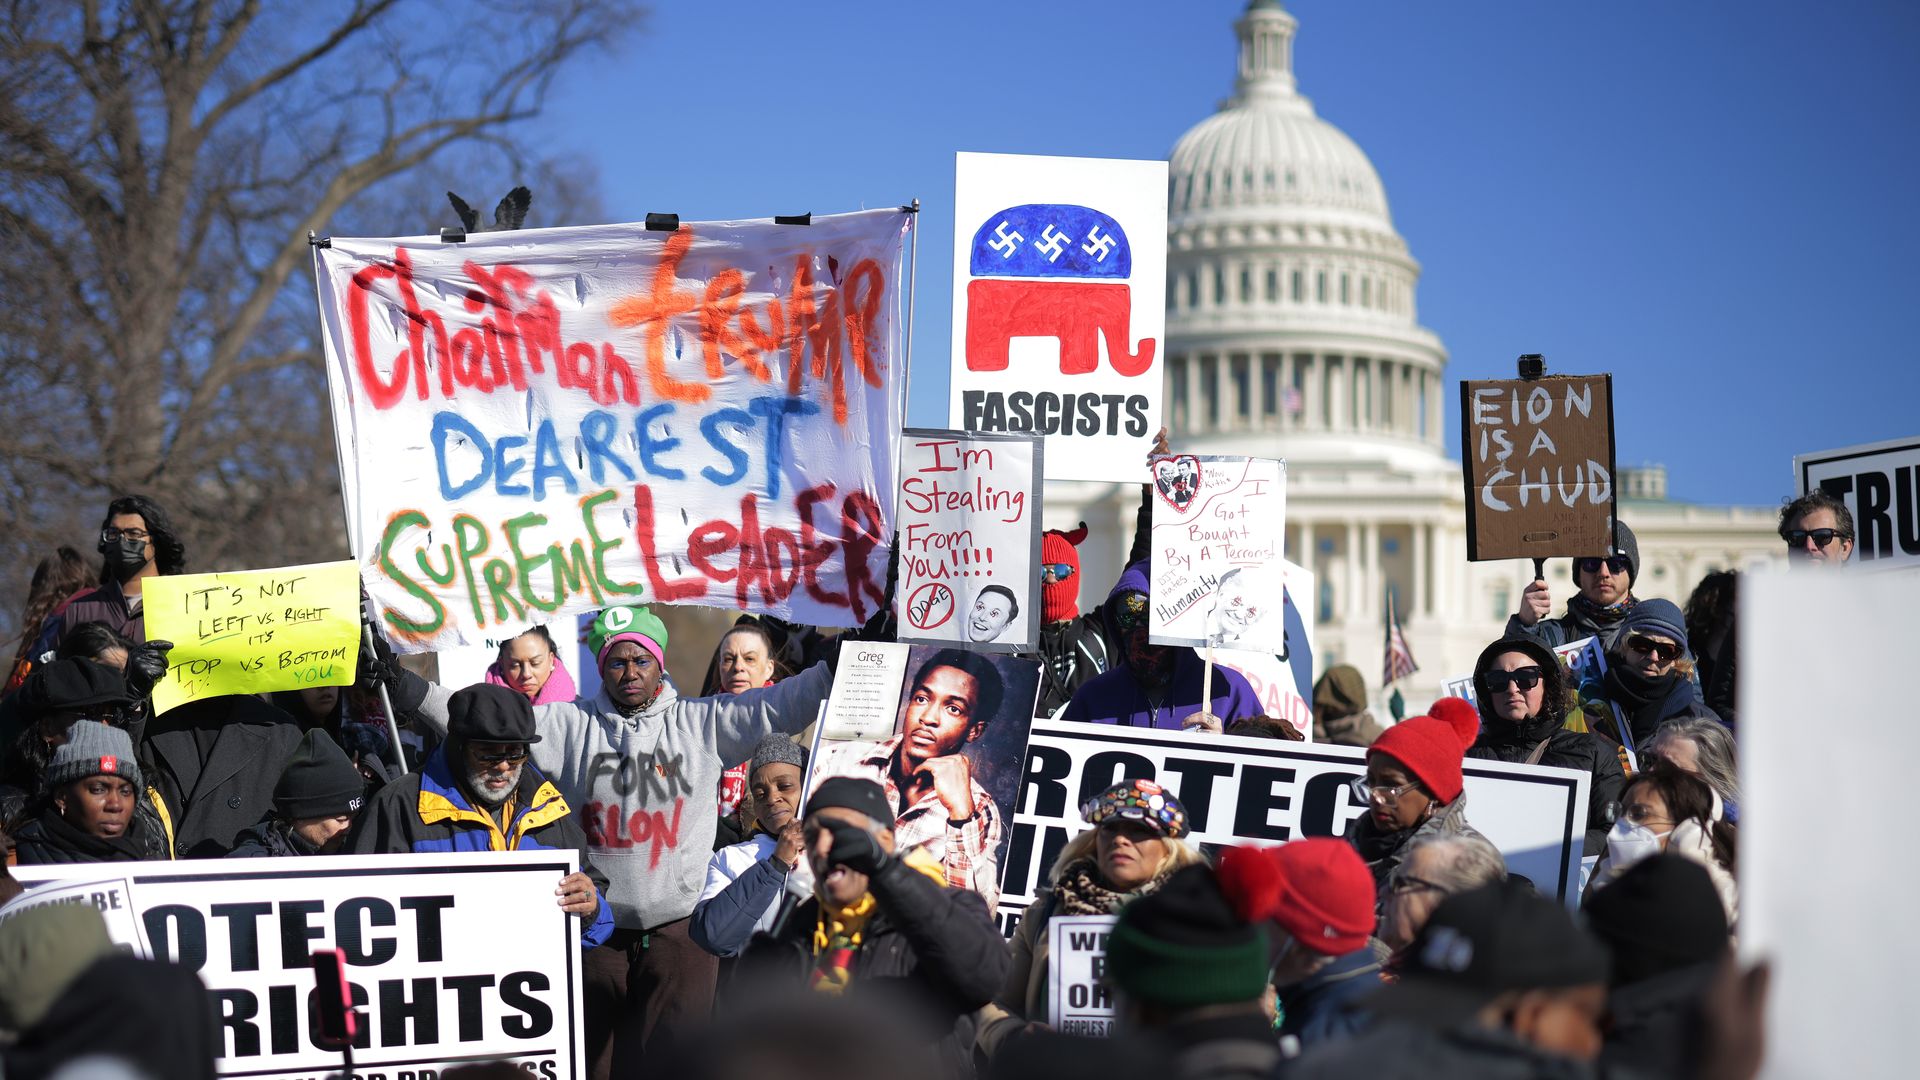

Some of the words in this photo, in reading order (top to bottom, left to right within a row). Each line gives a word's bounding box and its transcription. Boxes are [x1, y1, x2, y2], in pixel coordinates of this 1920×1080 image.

[962, 390, 1149, 437] FASCISTS
[915, 440, 993, 472] I'm
[1480, 428, 1514, 463] IS
[1528, 428, 1556, 457] A
[902, 477, 1025, 523] Stealing
[1243, 479, 1270, 497] I
[1481, 459, 1611, 512] CHUD
[1214, 502, 1250, 521] Got
[906, 523, 973, 552] From
[1188, 524, 1250, 546] Bought
[1165, 547, 1191, 571] By
[1201, 546, 1211, 560] A
[1216, 539, 1275, 560] Terrorist
[185, 585, 243, 614] IT'S
[259, 576, 307, 598] NOT
[909, 586, 950, 623] DOGE
[1156, 574, 1219, 622] Humanity
[198, 615, 252, 641] LEFT
[285, 607, 331, 622] RIGHT
[168, 658, 221, 683] TOP
[240, 656, 265, 672] VS
[279, 647, 346, 670] BOTTOM
[294, 664, 334, 684] YOU
[857, 651, 884, 665] Greg
[580, 796, 684, 871] ELON
[142, 895, 455, 976] OTECT
